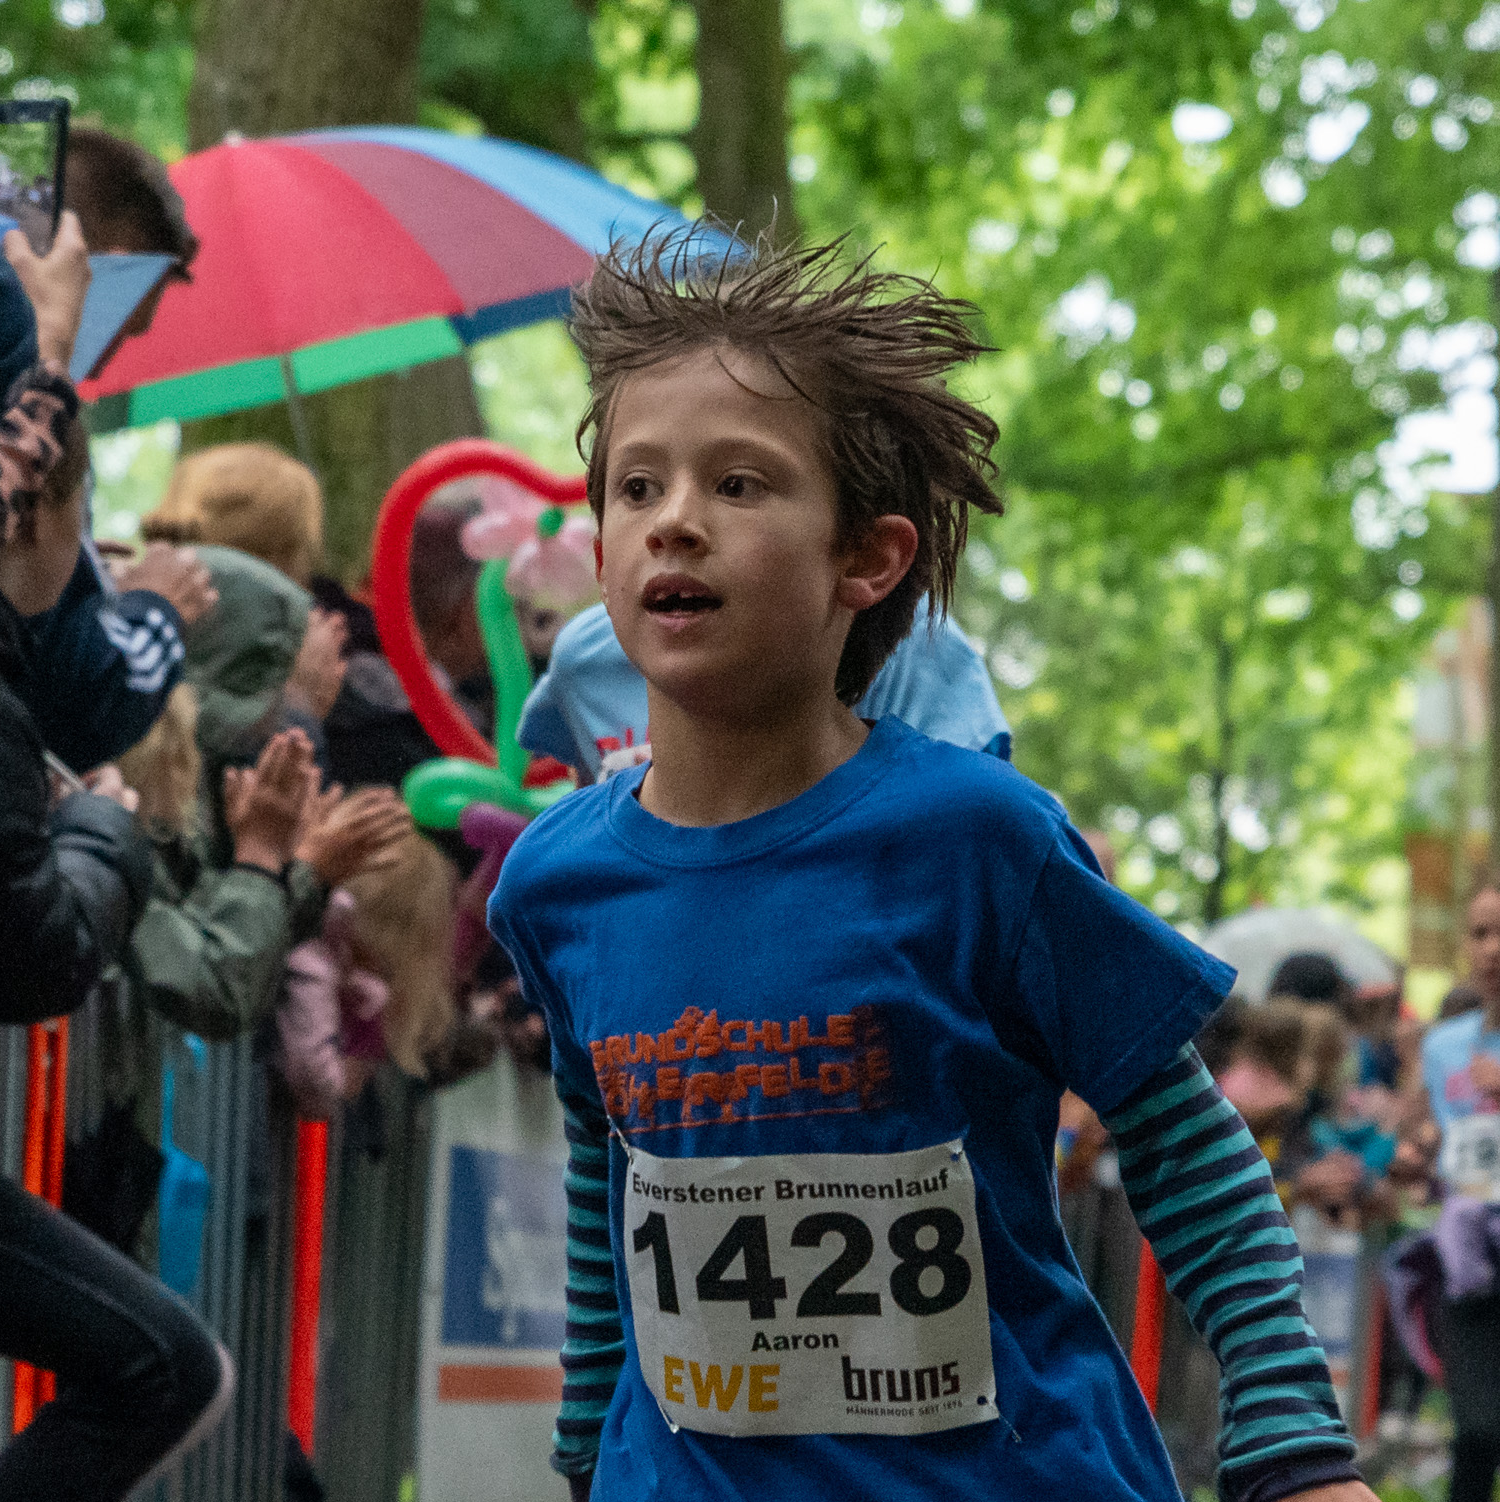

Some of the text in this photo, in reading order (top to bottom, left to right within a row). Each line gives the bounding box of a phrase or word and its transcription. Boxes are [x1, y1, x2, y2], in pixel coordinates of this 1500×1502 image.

[632, 1167, 950, 1204] Everstener Brunnenlauf
[632, 1206, 973, 1320] 1428
[750, 1331, 840, 1353] Aaron
[663, 1355, 781, 1413] EWE
[841, 1355, 960, 1402] bruns
